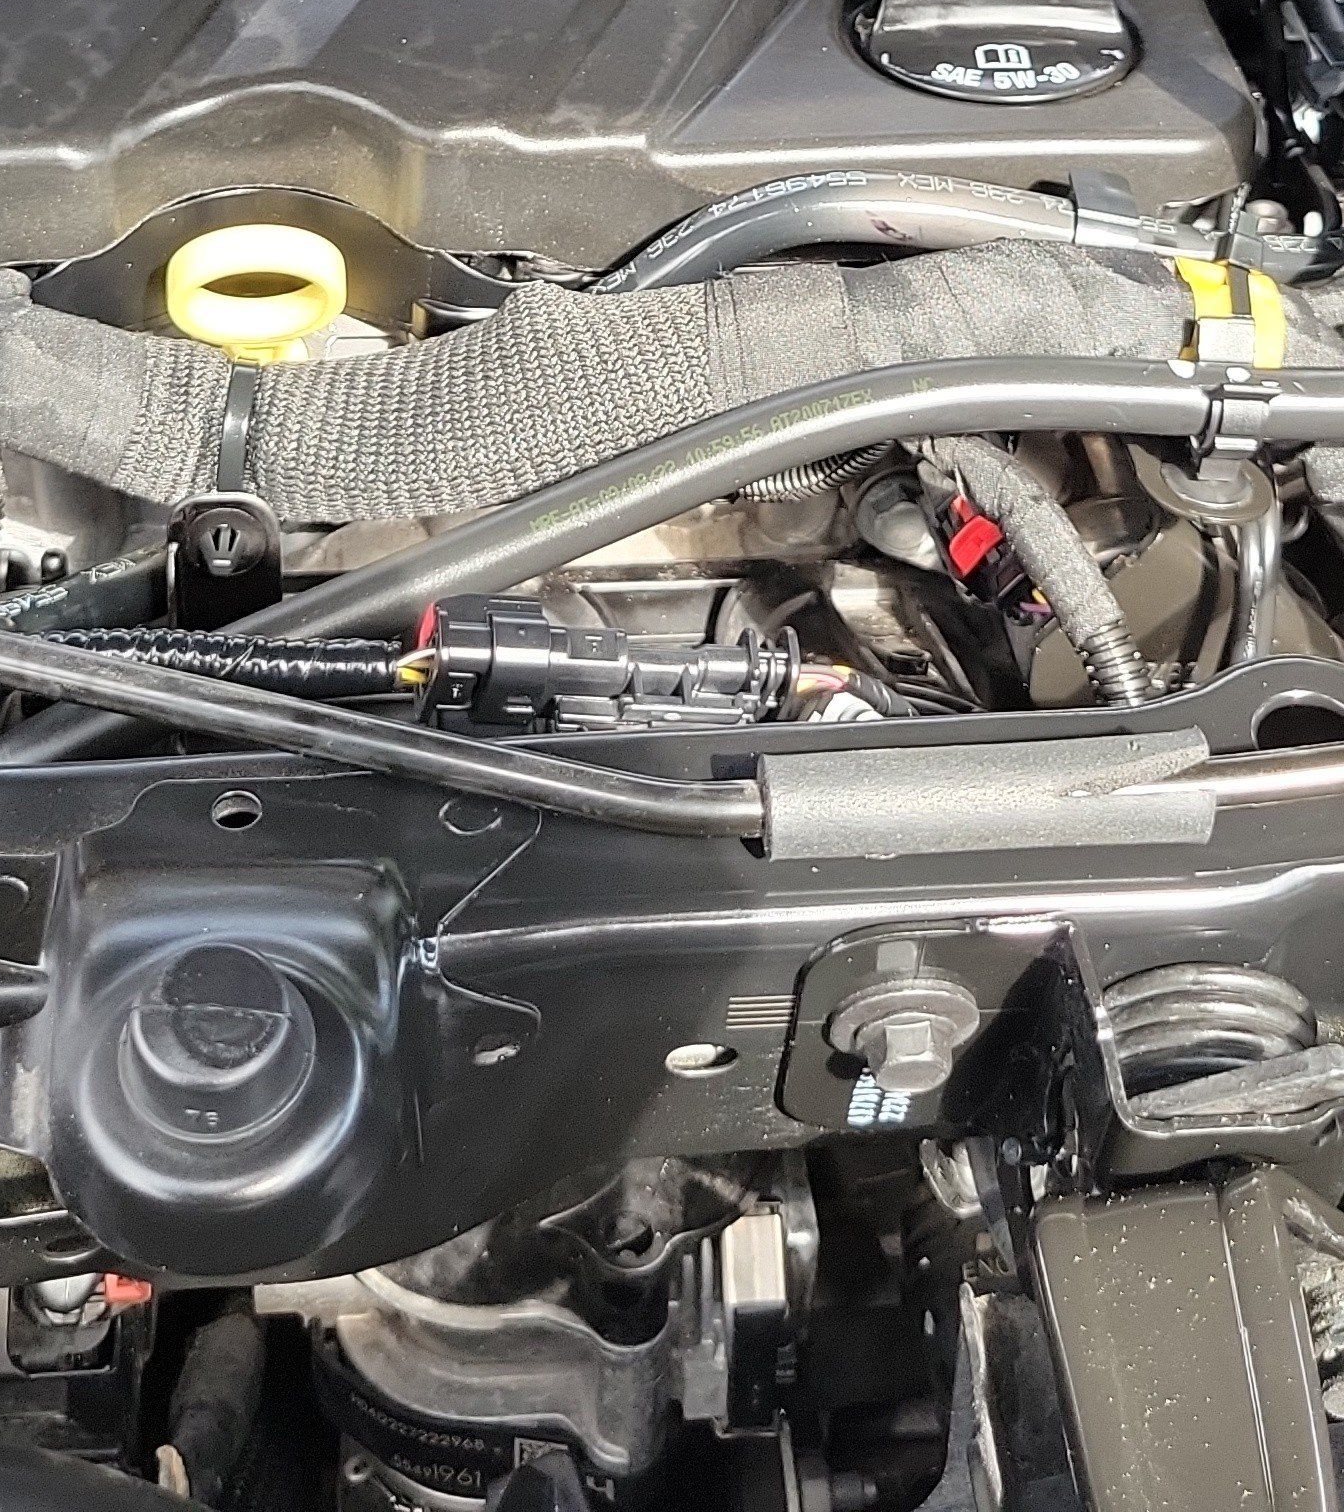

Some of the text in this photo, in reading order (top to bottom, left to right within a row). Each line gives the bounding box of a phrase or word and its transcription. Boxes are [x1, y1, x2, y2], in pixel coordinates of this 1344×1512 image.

[931, 62, 1080, 89] SAE 5W-30
[897, 172, 954, 194] MEX
